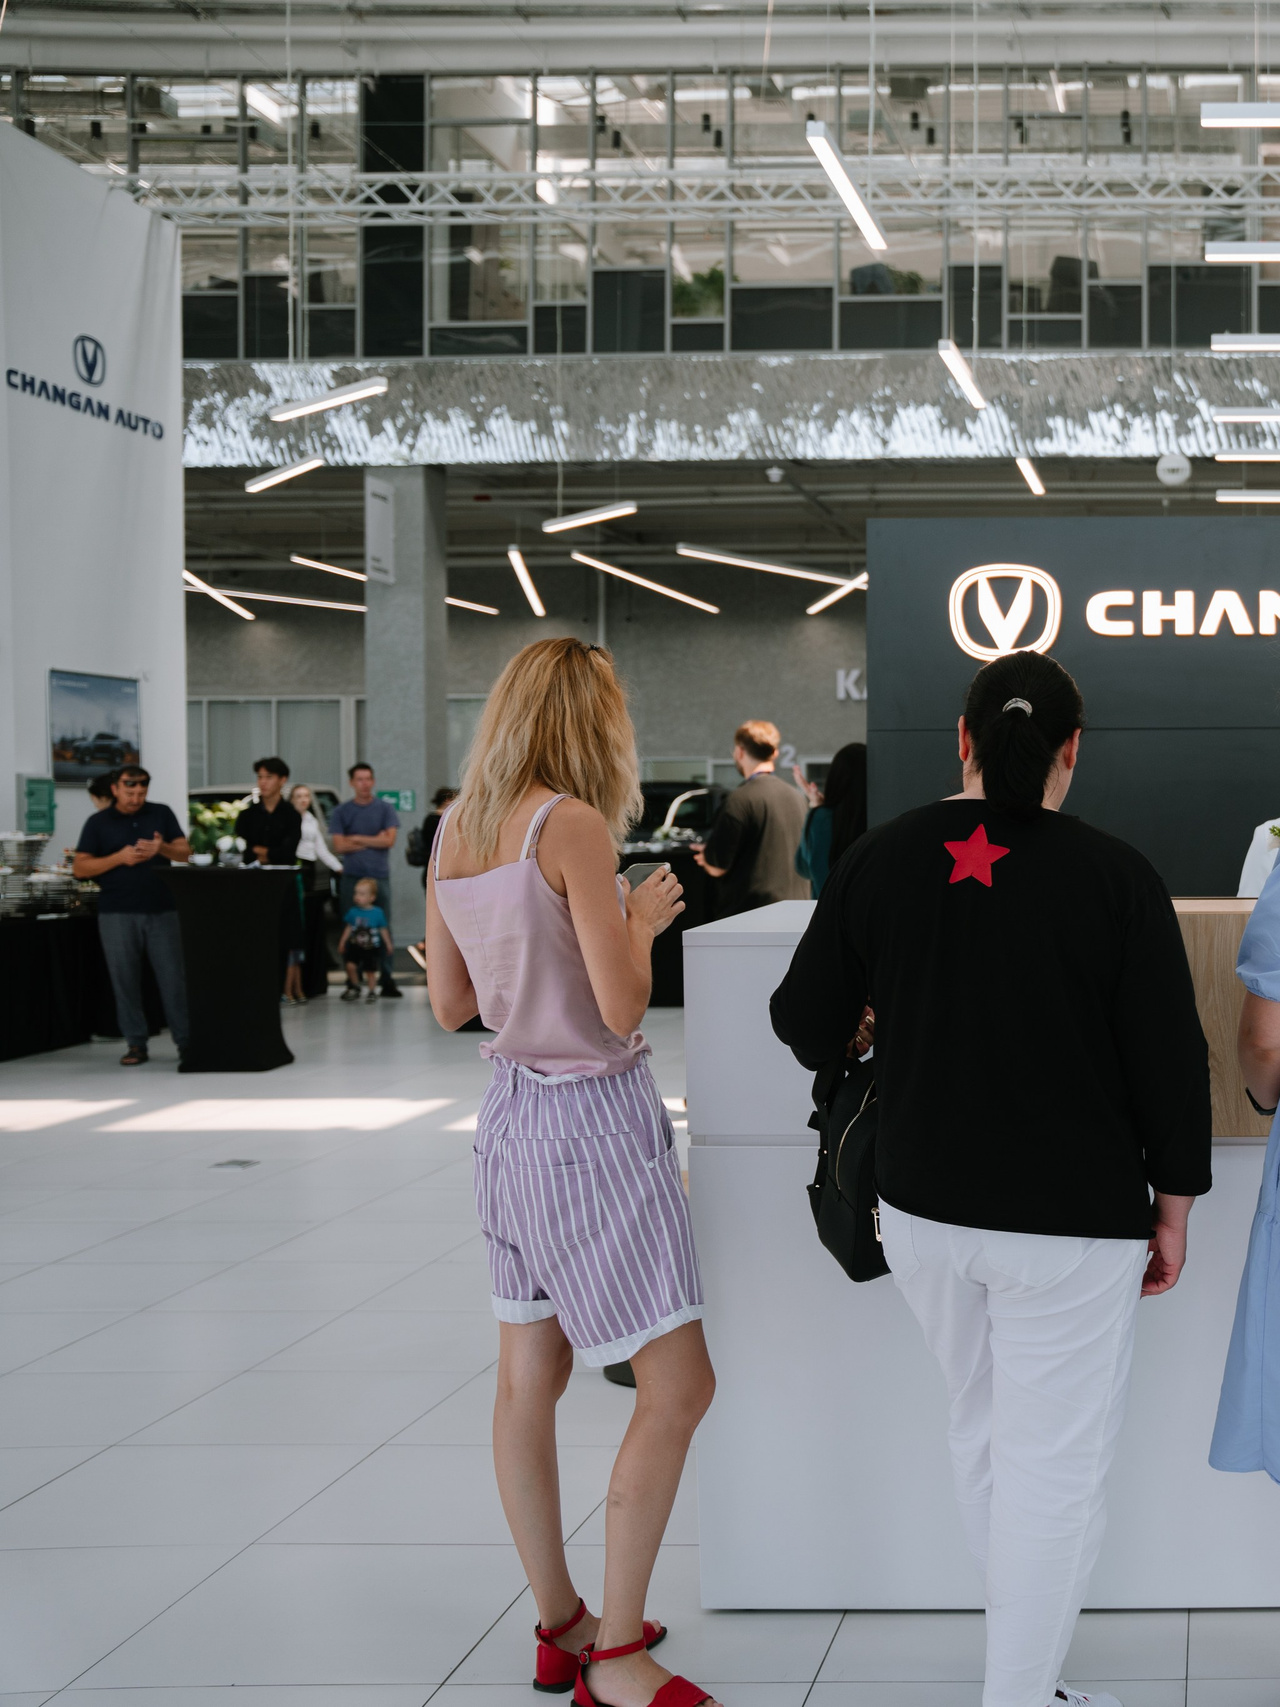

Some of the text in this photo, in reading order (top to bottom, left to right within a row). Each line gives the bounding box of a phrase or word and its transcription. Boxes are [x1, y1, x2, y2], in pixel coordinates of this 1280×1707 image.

[6, 368, 164, 440] CHANGAN AUTO
[780, 744, 796, 769] 2
